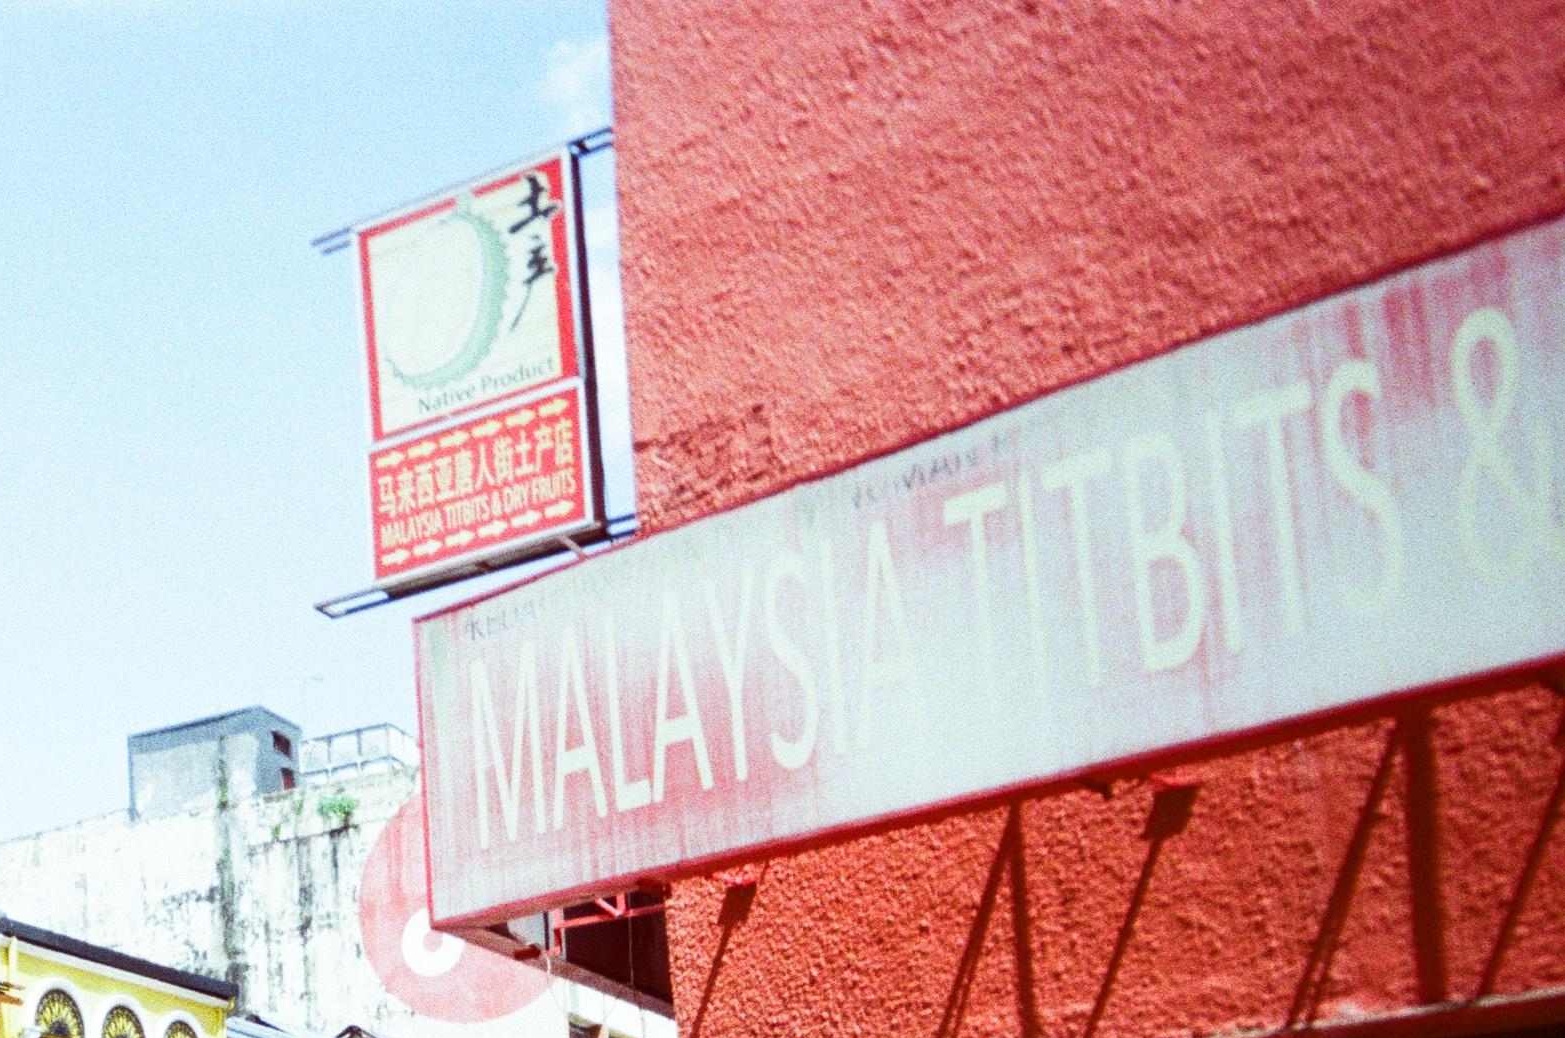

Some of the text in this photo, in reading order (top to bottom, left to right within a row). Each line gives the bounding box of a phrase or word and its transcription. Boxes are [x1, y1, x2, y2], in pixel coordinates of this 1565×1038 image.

[418, 357, 553, 414] Native Product
[377, 417, 574, 518] 马来西亚唐人街土产店
[380, 467, 577, 547] MALAYSIA TITBITS & DRY FRUITS
[469, 307, 1565, 849] MALAYSIA TITBITS &
